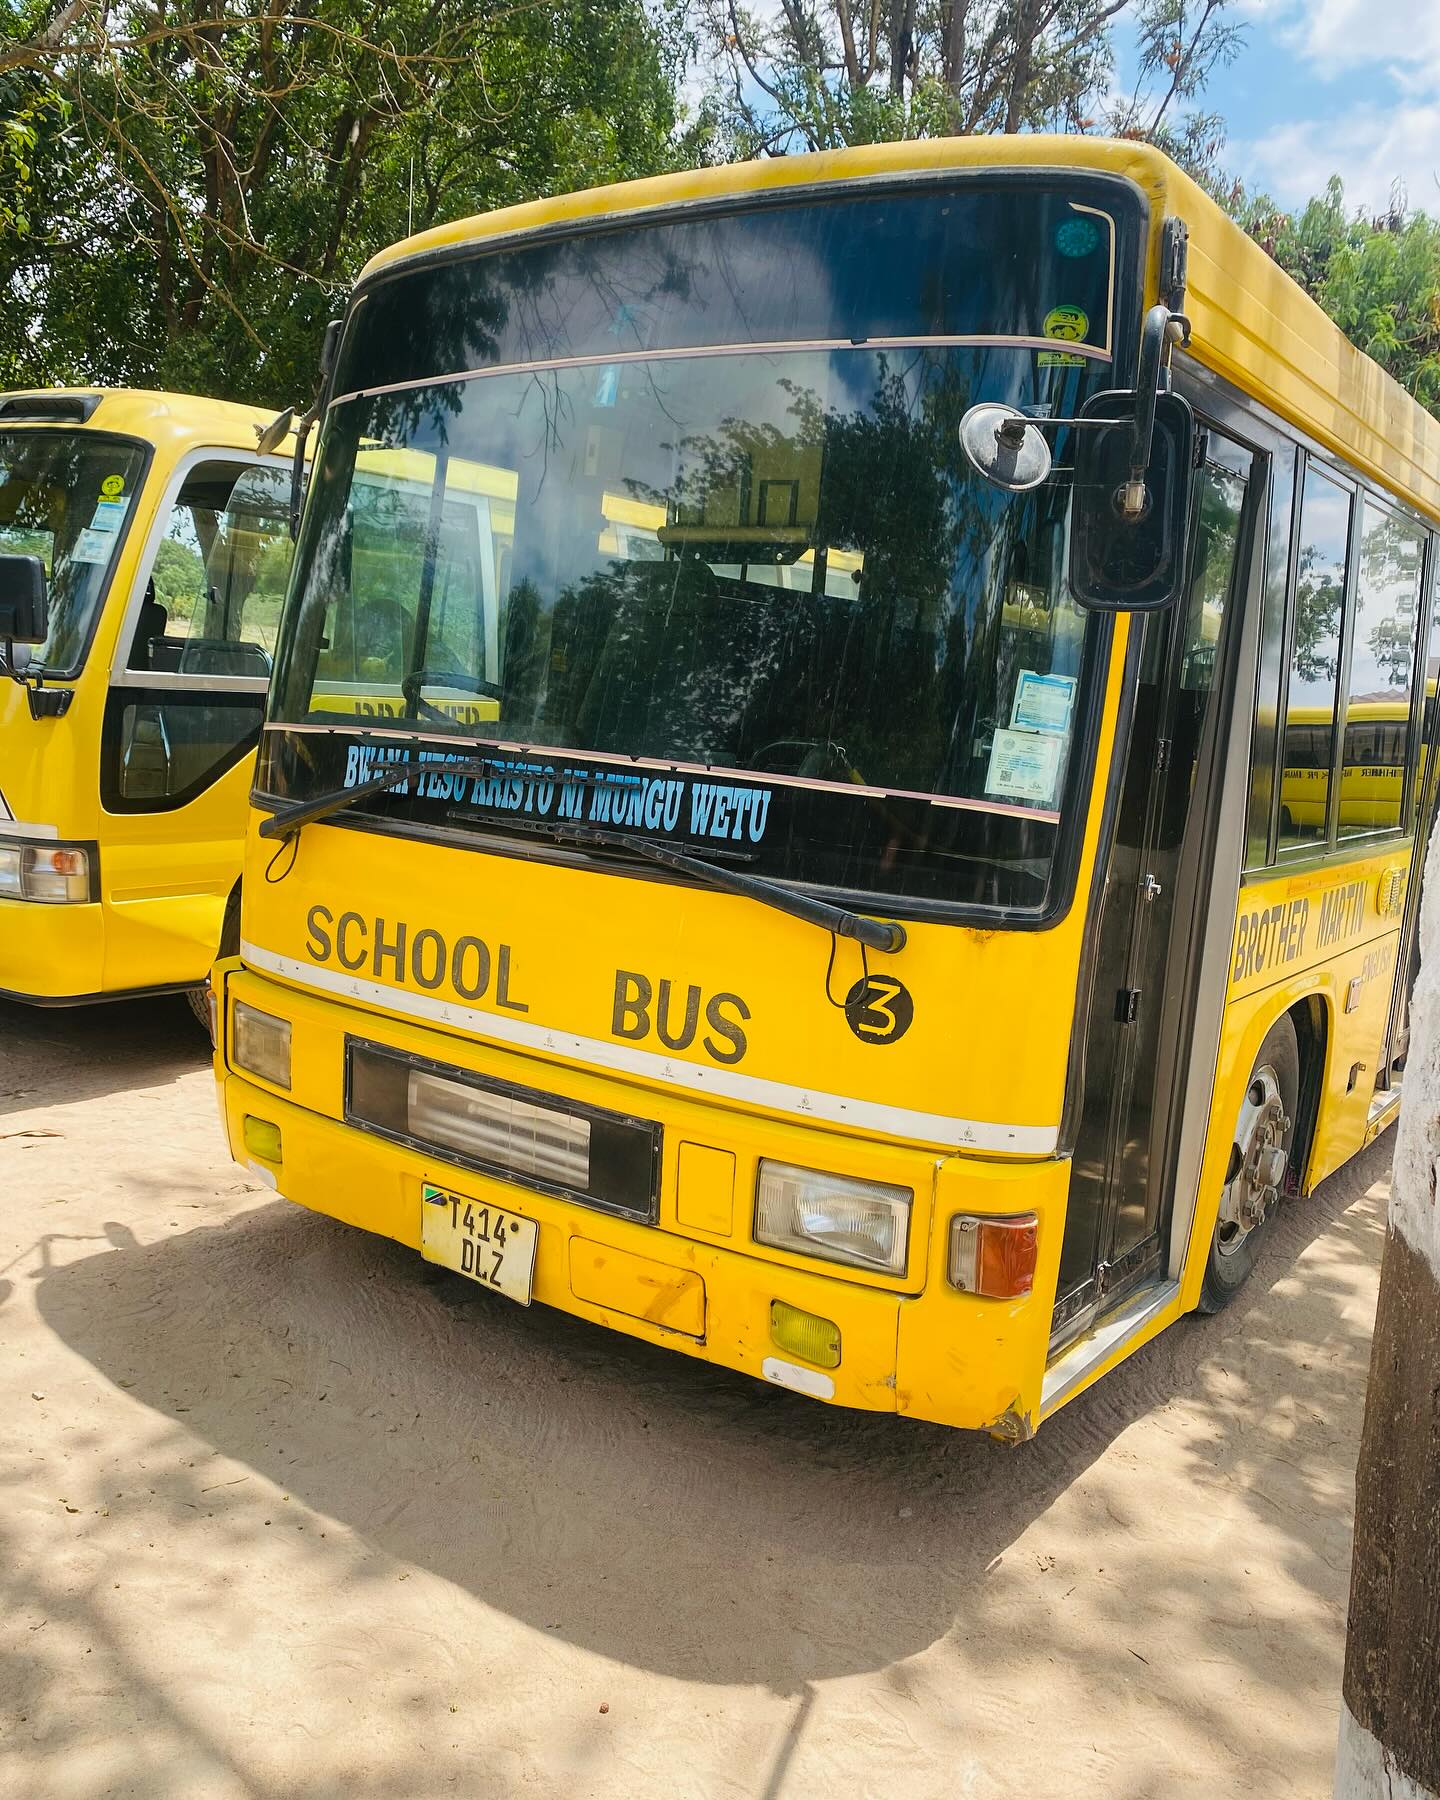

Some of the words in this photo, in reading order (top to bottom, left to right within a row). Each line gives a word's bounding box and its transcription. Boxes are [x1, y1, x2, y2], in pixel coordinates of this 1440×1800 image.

[416, 752, 470, 801] YESU
[470, 757, 555, 815] KRISTO
[557, 768, 589, 819] NI
[588, 772, 684, 832] MUNGU
[690, 783, 772, 843] WETU
[1233, 898, 1309, 983] BROTHER
[1316, 880, 1368, 950] MARTIN
[305, 904, 529, 1013] SCHOOL
[611, 969, 752, 1065] BUS
[858, 980, 901, 1037] 3
[448, 1195, 506, 1248] T414
[461, 1238, 504, 1288] DLZ
